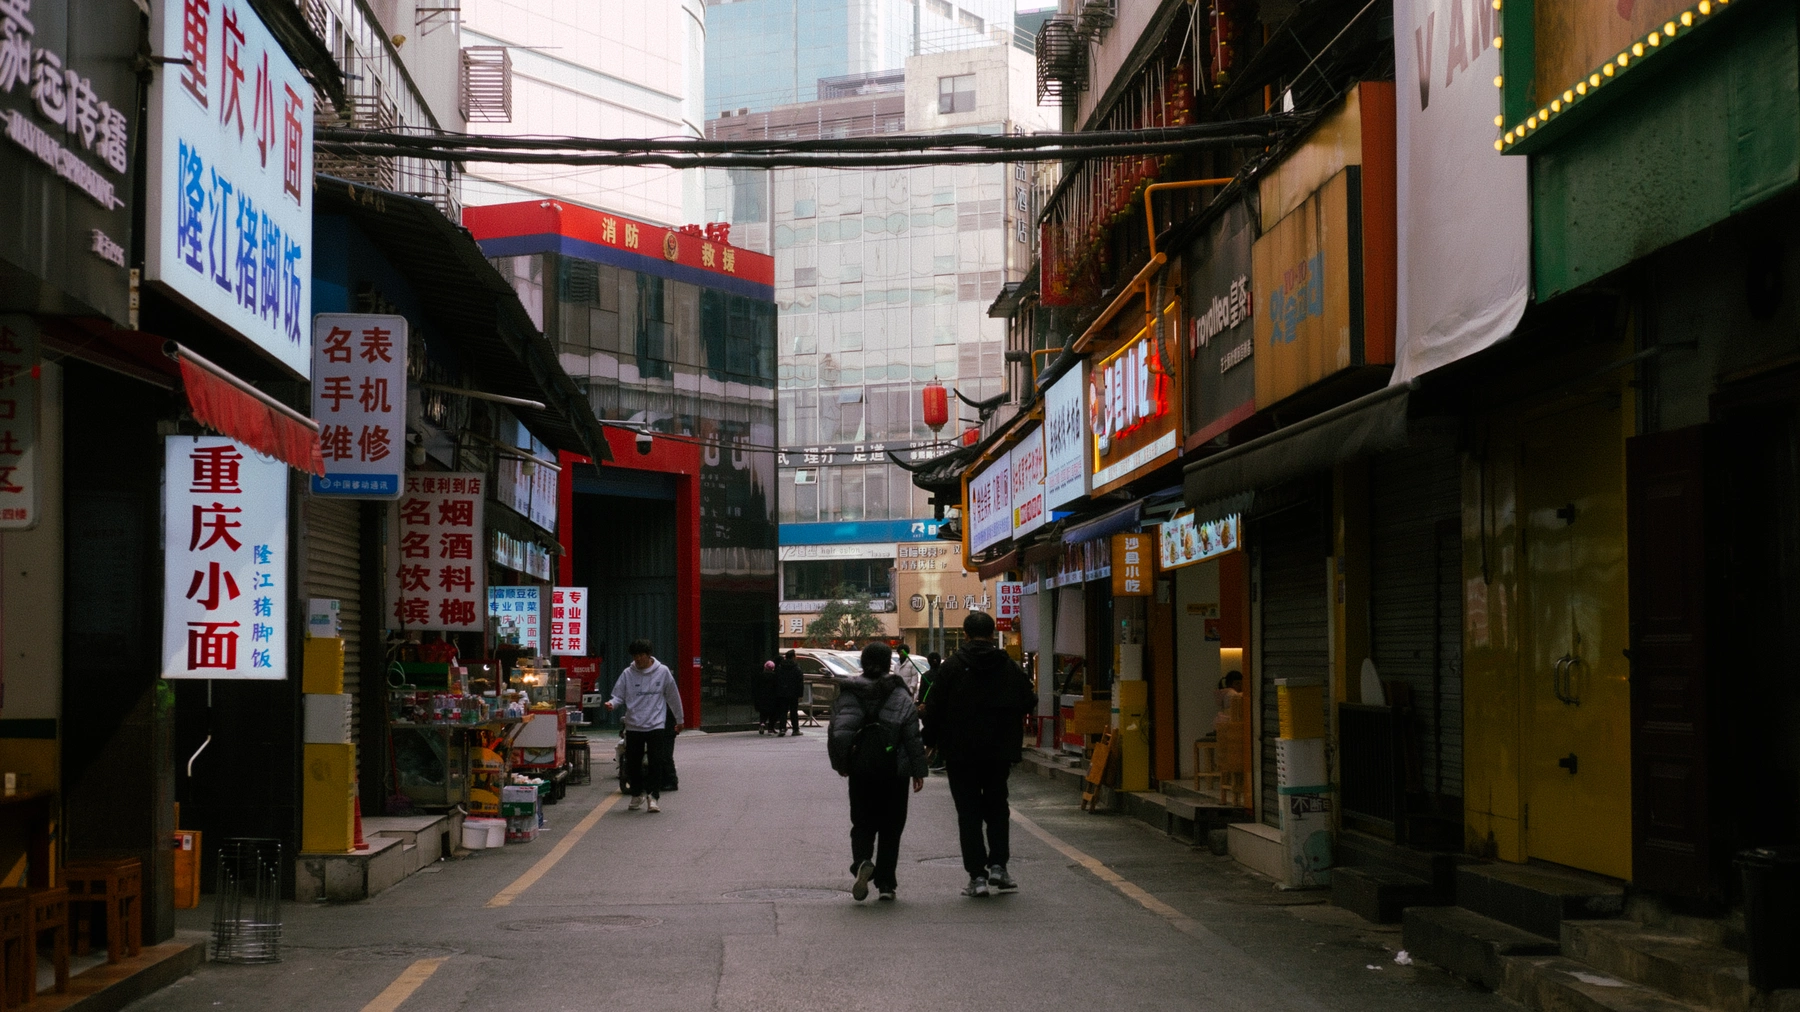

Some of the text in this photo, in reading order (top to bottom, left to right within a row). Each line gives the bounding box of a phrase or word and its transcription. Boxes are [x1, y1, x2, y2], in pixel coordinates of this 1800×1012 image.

[180, 0, 304, 207] 重庆小面
[177, 137, 302, 345] 隆江猪脚饭
[601, 217, 736, 274] 消防 救援
[323, 326, 393, 364] 名表
[320, 376, 392, 414] 手机
[320, 424, 392, 463] 维修
[803, 446, 837, 465] 理疗
[851, 443, 885, 463] 足道
[400, 498, 474, 527] 名烟
[185, 444, 244, 672] 重庆小面
[400, 530, 473, 560] 名酒
[395, 563, 475, 593] 饮料
[1124, 537, 1141, 594] 沙县小吃
[251, 543, 275, 669] 隆江猪脚饭
[489, 601, 538, 612] 专业冒菜
[495, 588, 538, 599] 富顺豆花
[932, 594, 991, 609] 品酒店
[1001, 585, 1022, 595] 自选
[394, 597, 476, 627] 槟榔
[497, 614, 538, 625] 庆小面
[551, 591, 565, 650] 富顺豆花
[568, 591, 582, 651] 专业冒菜
[527, 627, 538, 637] 面
